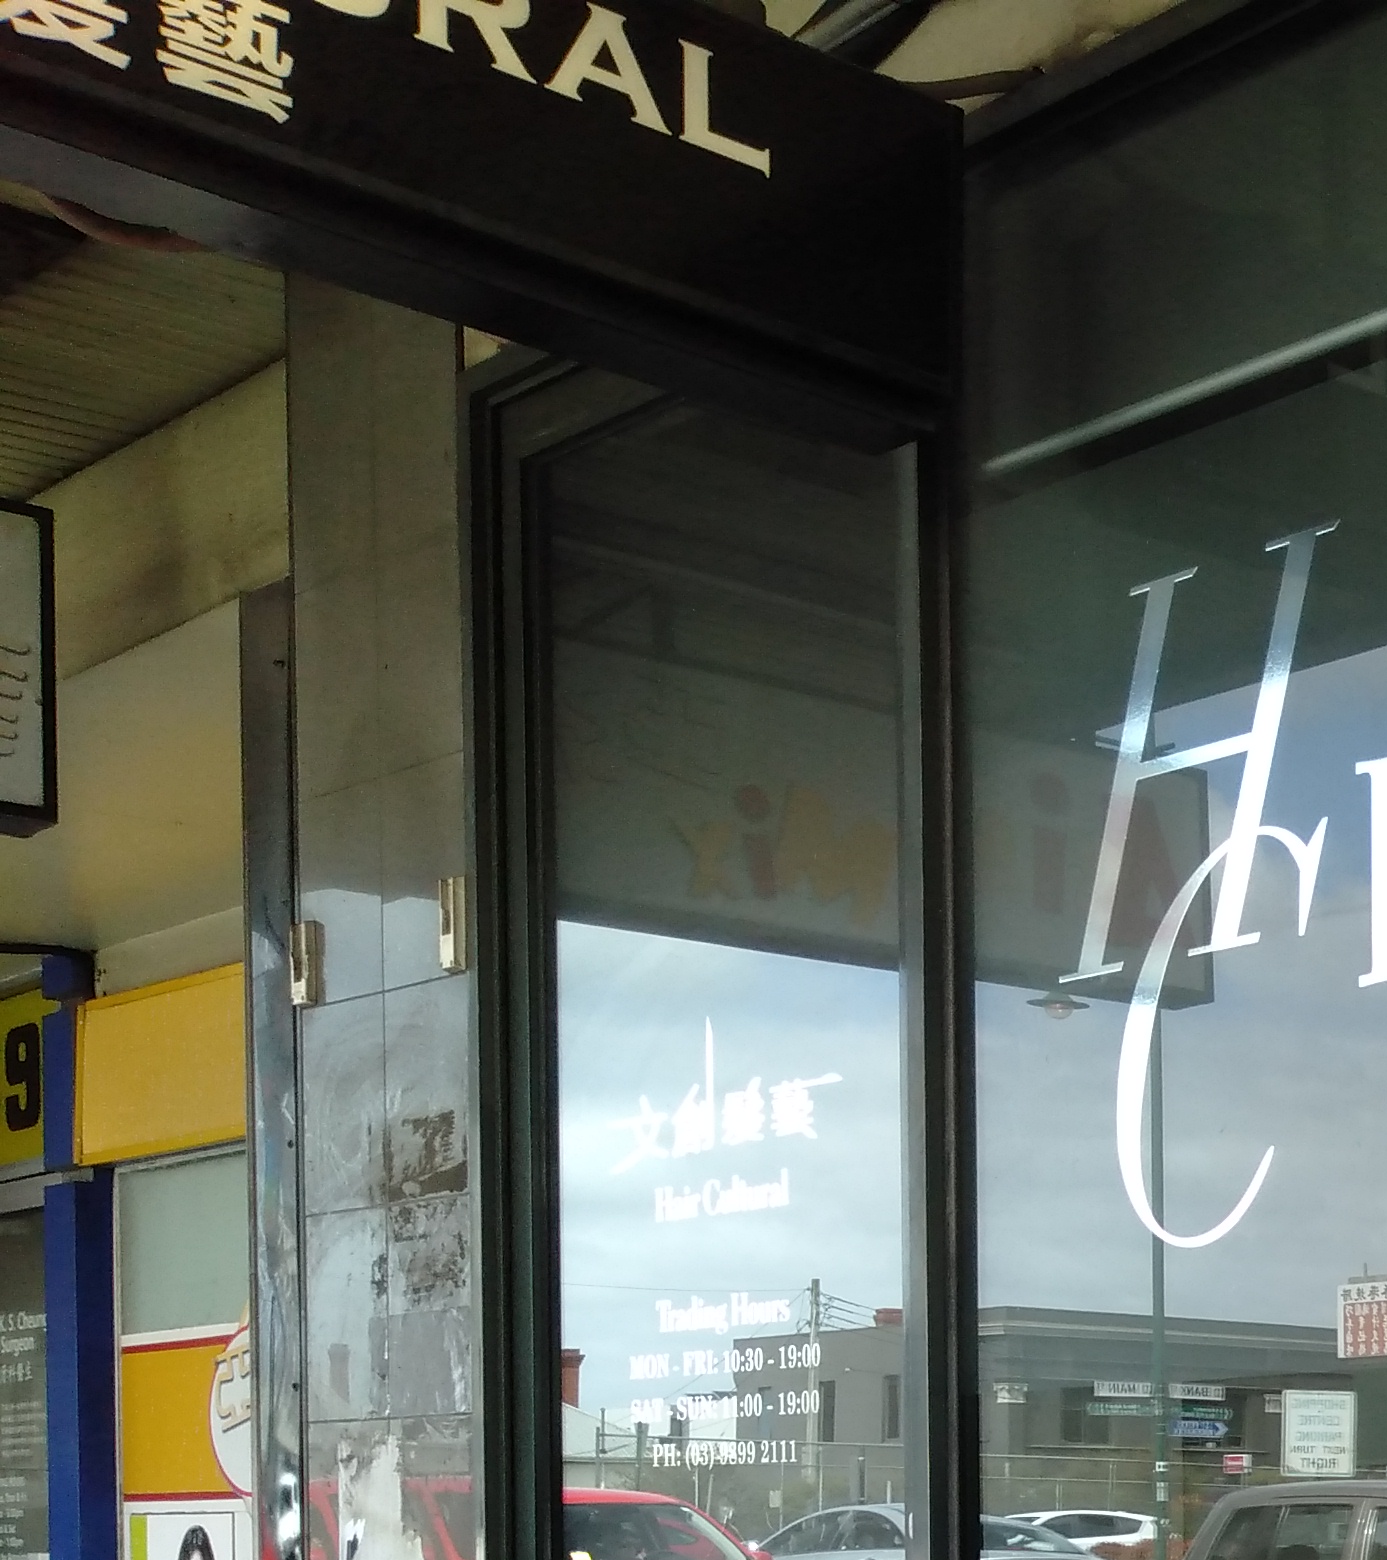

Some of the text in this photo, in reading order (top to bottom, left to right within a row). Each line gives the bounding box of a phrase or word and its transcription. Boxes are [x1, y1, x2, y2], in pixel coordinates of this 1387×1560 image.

[655, 1167, 790, 1222] Hair Cultural
[656, 1292, 791, 1335] Trading Hours
[629, 1353, 671, 1381] MON
[723, 1347, 764, 1374] 10:30
[778, 1343, 821, 1370] 19:00
[721, 1393, 763, 1418] 11:00
[778, 1390, 821, 1416] 19:00
[652, 1439, 798, 1471] PH: (03) 9899 2111
